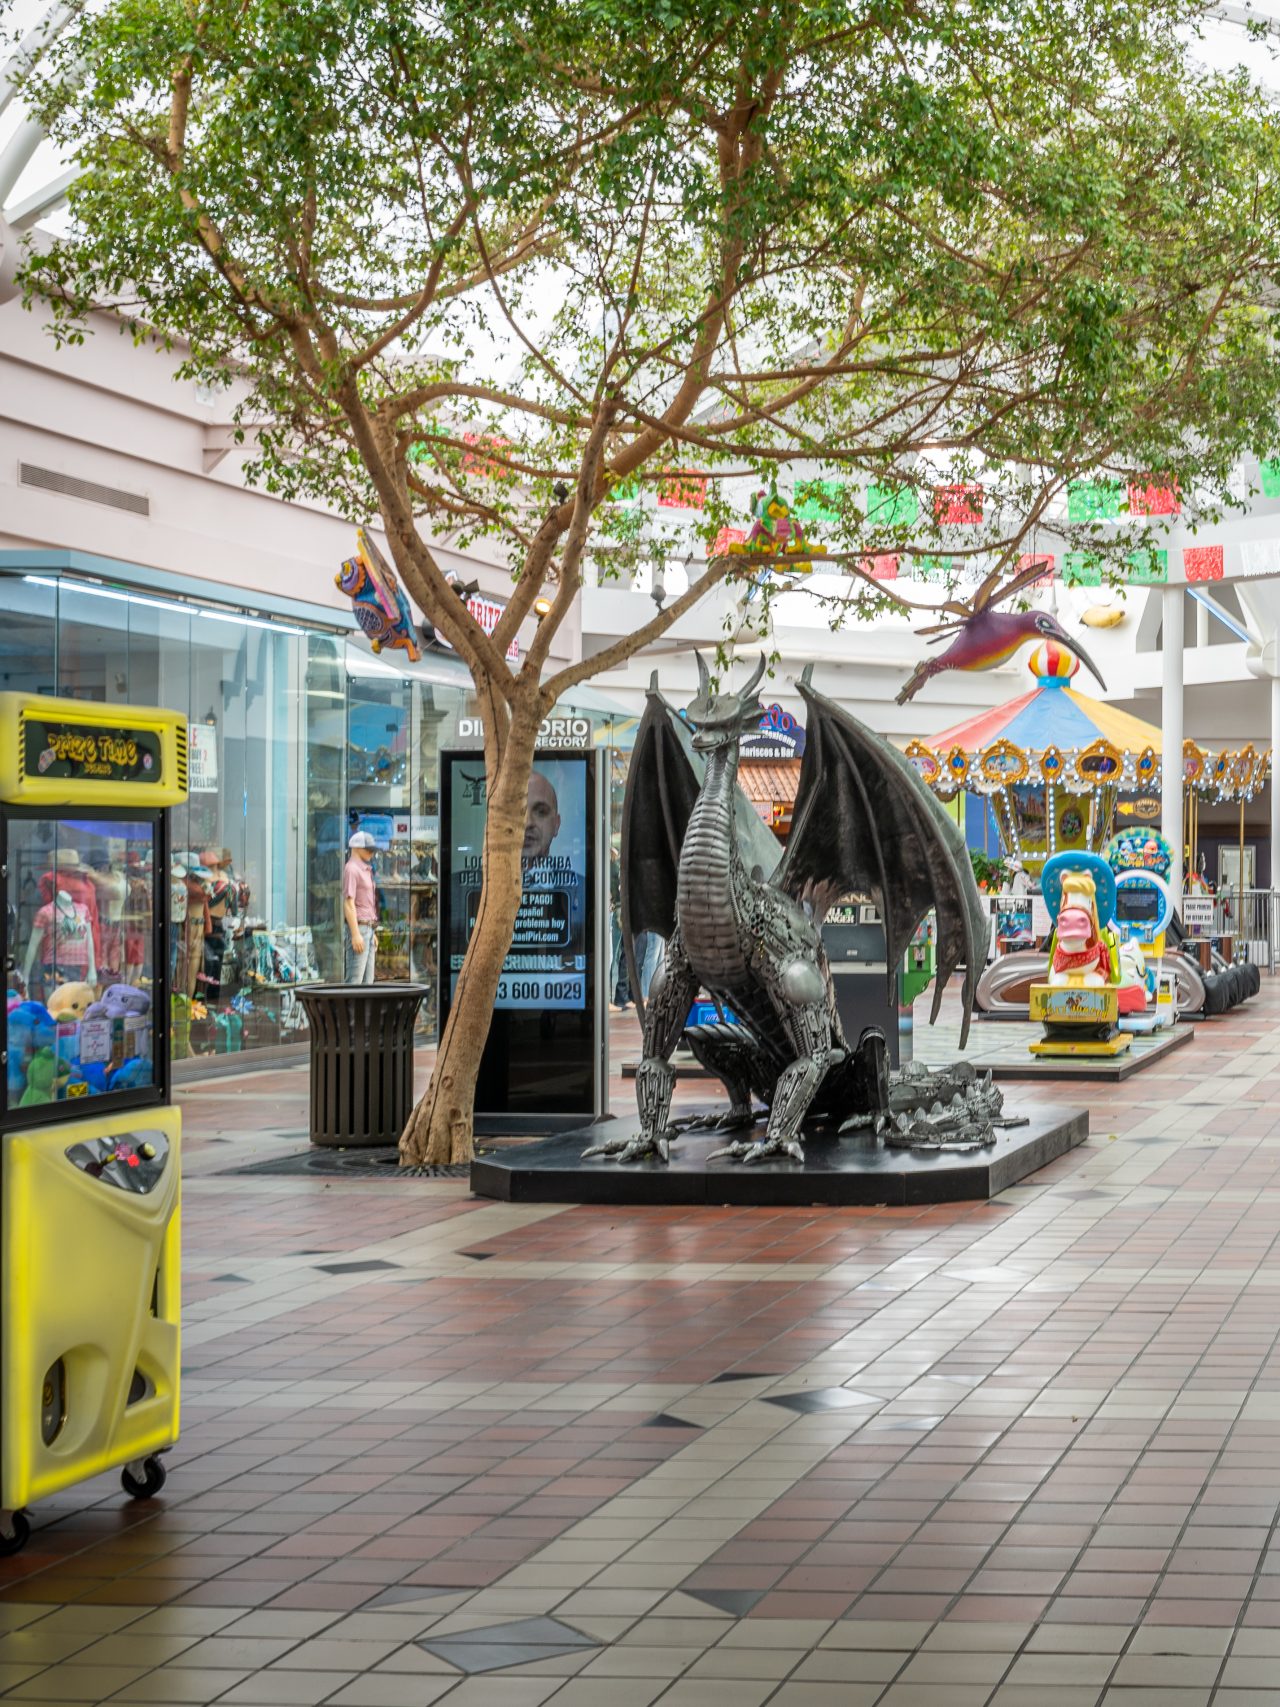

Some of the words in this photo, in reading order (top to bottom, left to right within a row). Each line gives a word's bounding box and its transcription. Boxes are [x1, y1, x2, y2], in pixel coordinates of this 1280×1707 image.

[780, 747, 795, 758] Bar
[533, 856, 571, 869] ARRIBA
[534, 872, 578, 886] COMIDA
[530, 894, 553, 905] PAGO!
[517, 906, 543, 919] spañol
[515, 917, 549, 931] problema
[552, 918, 565, 931] hoy
[512, 982, 539, 1000] 600
[545, 982, 582, 1000] 0029
